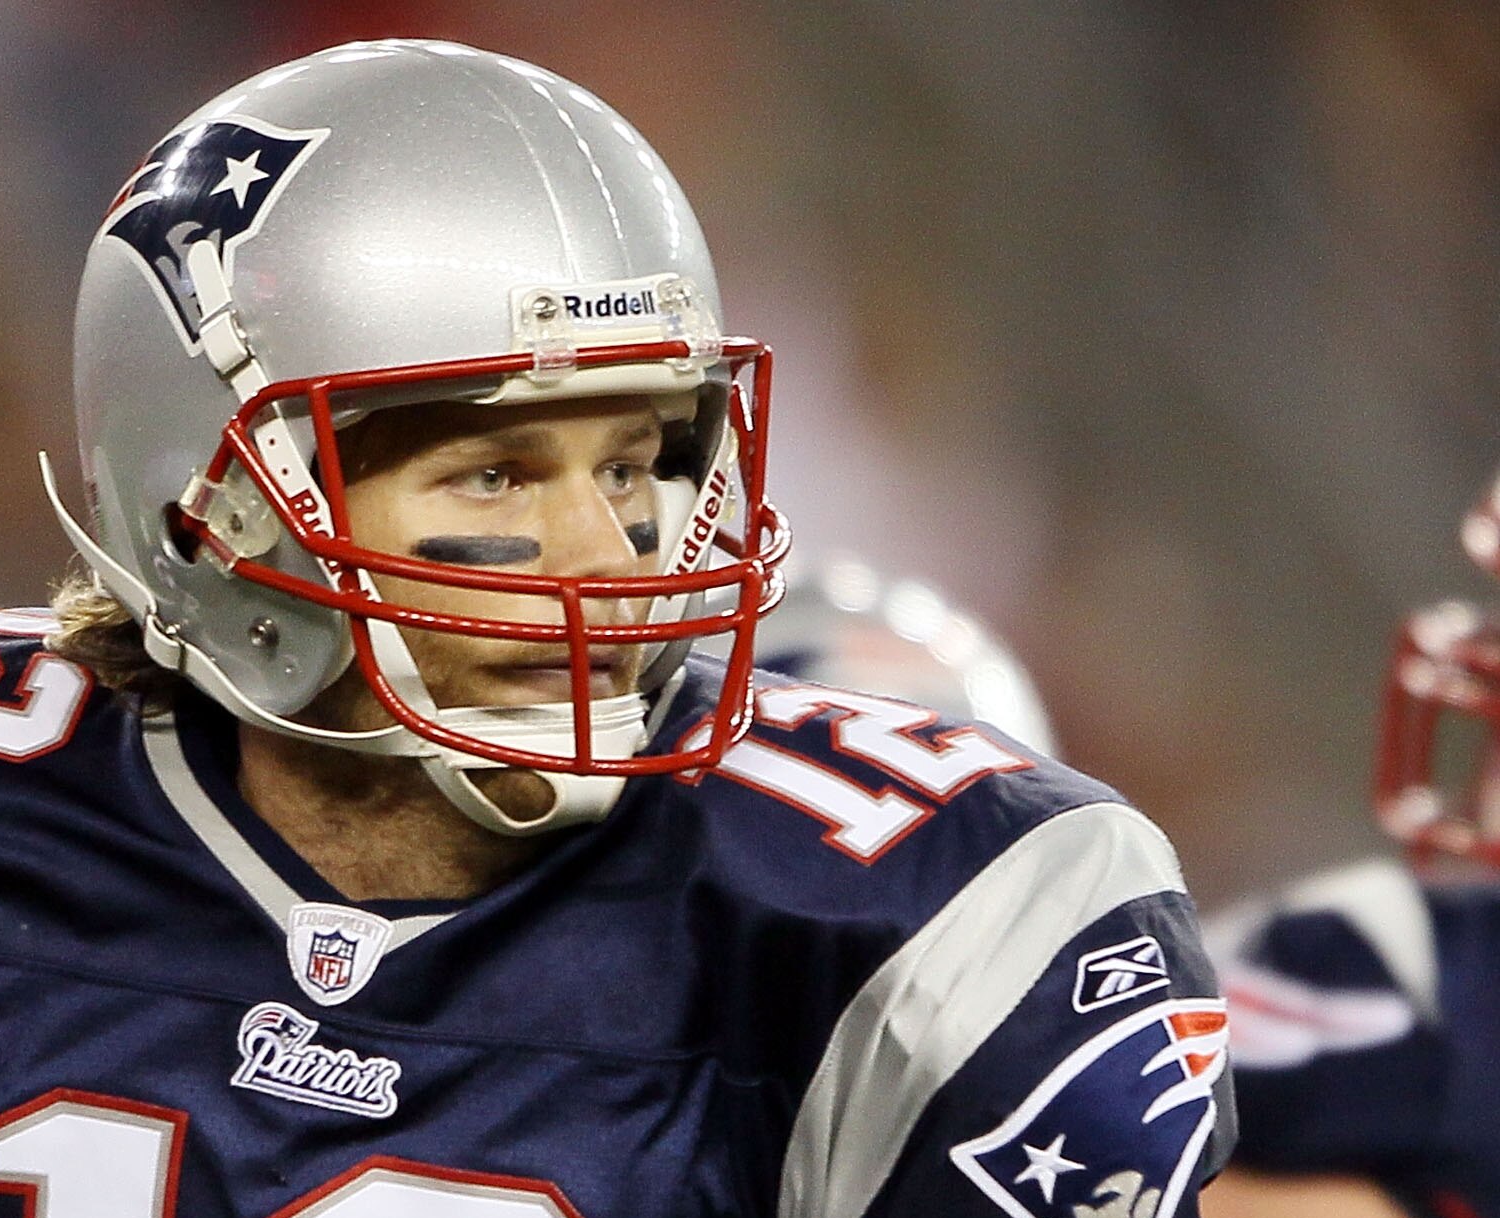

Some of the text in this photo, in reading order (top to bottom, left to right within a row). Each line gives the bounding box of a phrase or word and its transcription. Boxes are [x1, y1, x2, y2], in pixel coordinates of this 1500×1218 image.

[561, 290, 657, 319] Riddell
[667, 469, 728, 581] iddell
[672, 683, 1036, 866] 12
[310, 954, 350, 986] NFL
[244, 1029, 397, 1106] Patriots
